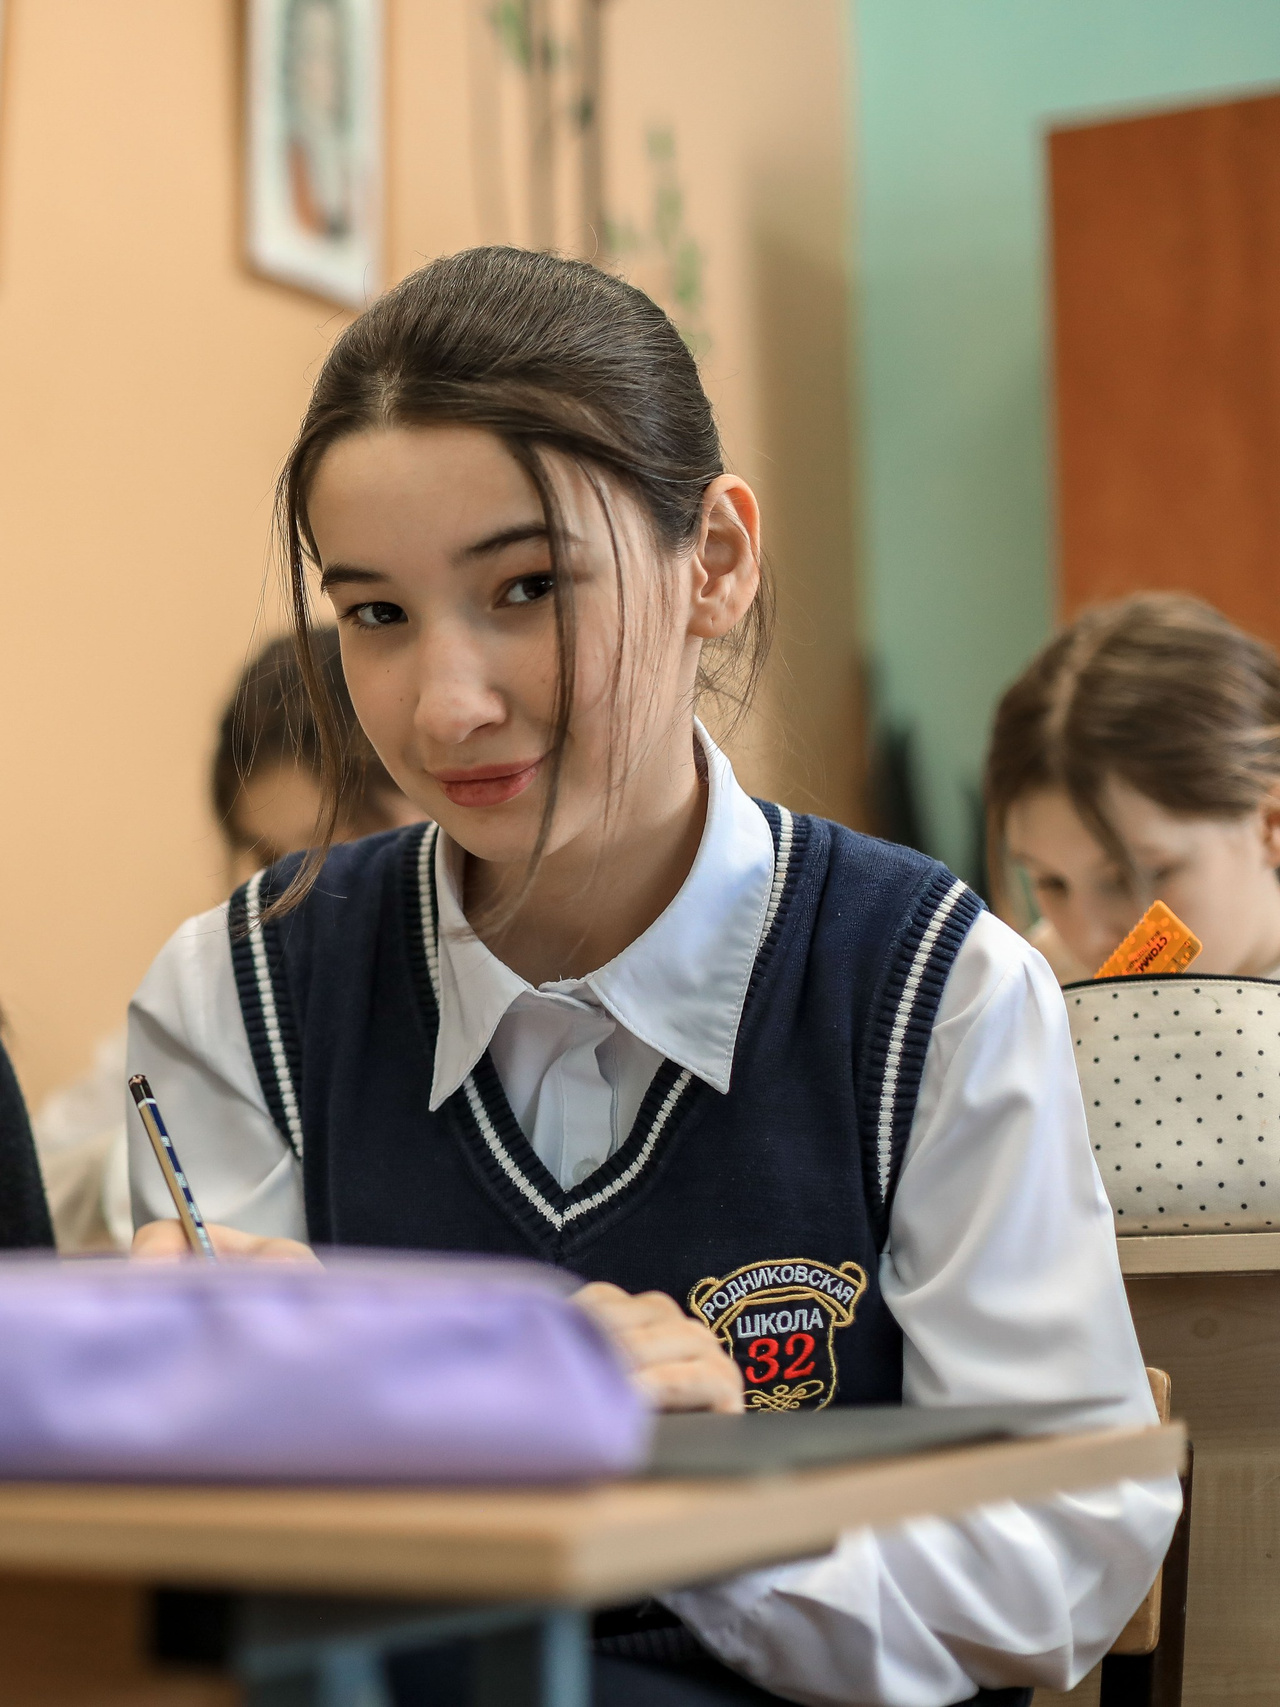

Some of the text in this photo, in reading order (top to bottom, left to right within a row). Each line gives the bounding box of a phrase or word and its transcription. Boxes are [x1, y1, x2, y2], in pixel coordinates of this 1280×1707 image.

[701, 1265, 855, 1320] РОДНИКОВСКАЯ
[736, 1308, 824, 1339] ШКОЛА
[745, 1333, 816, 1384] 32
